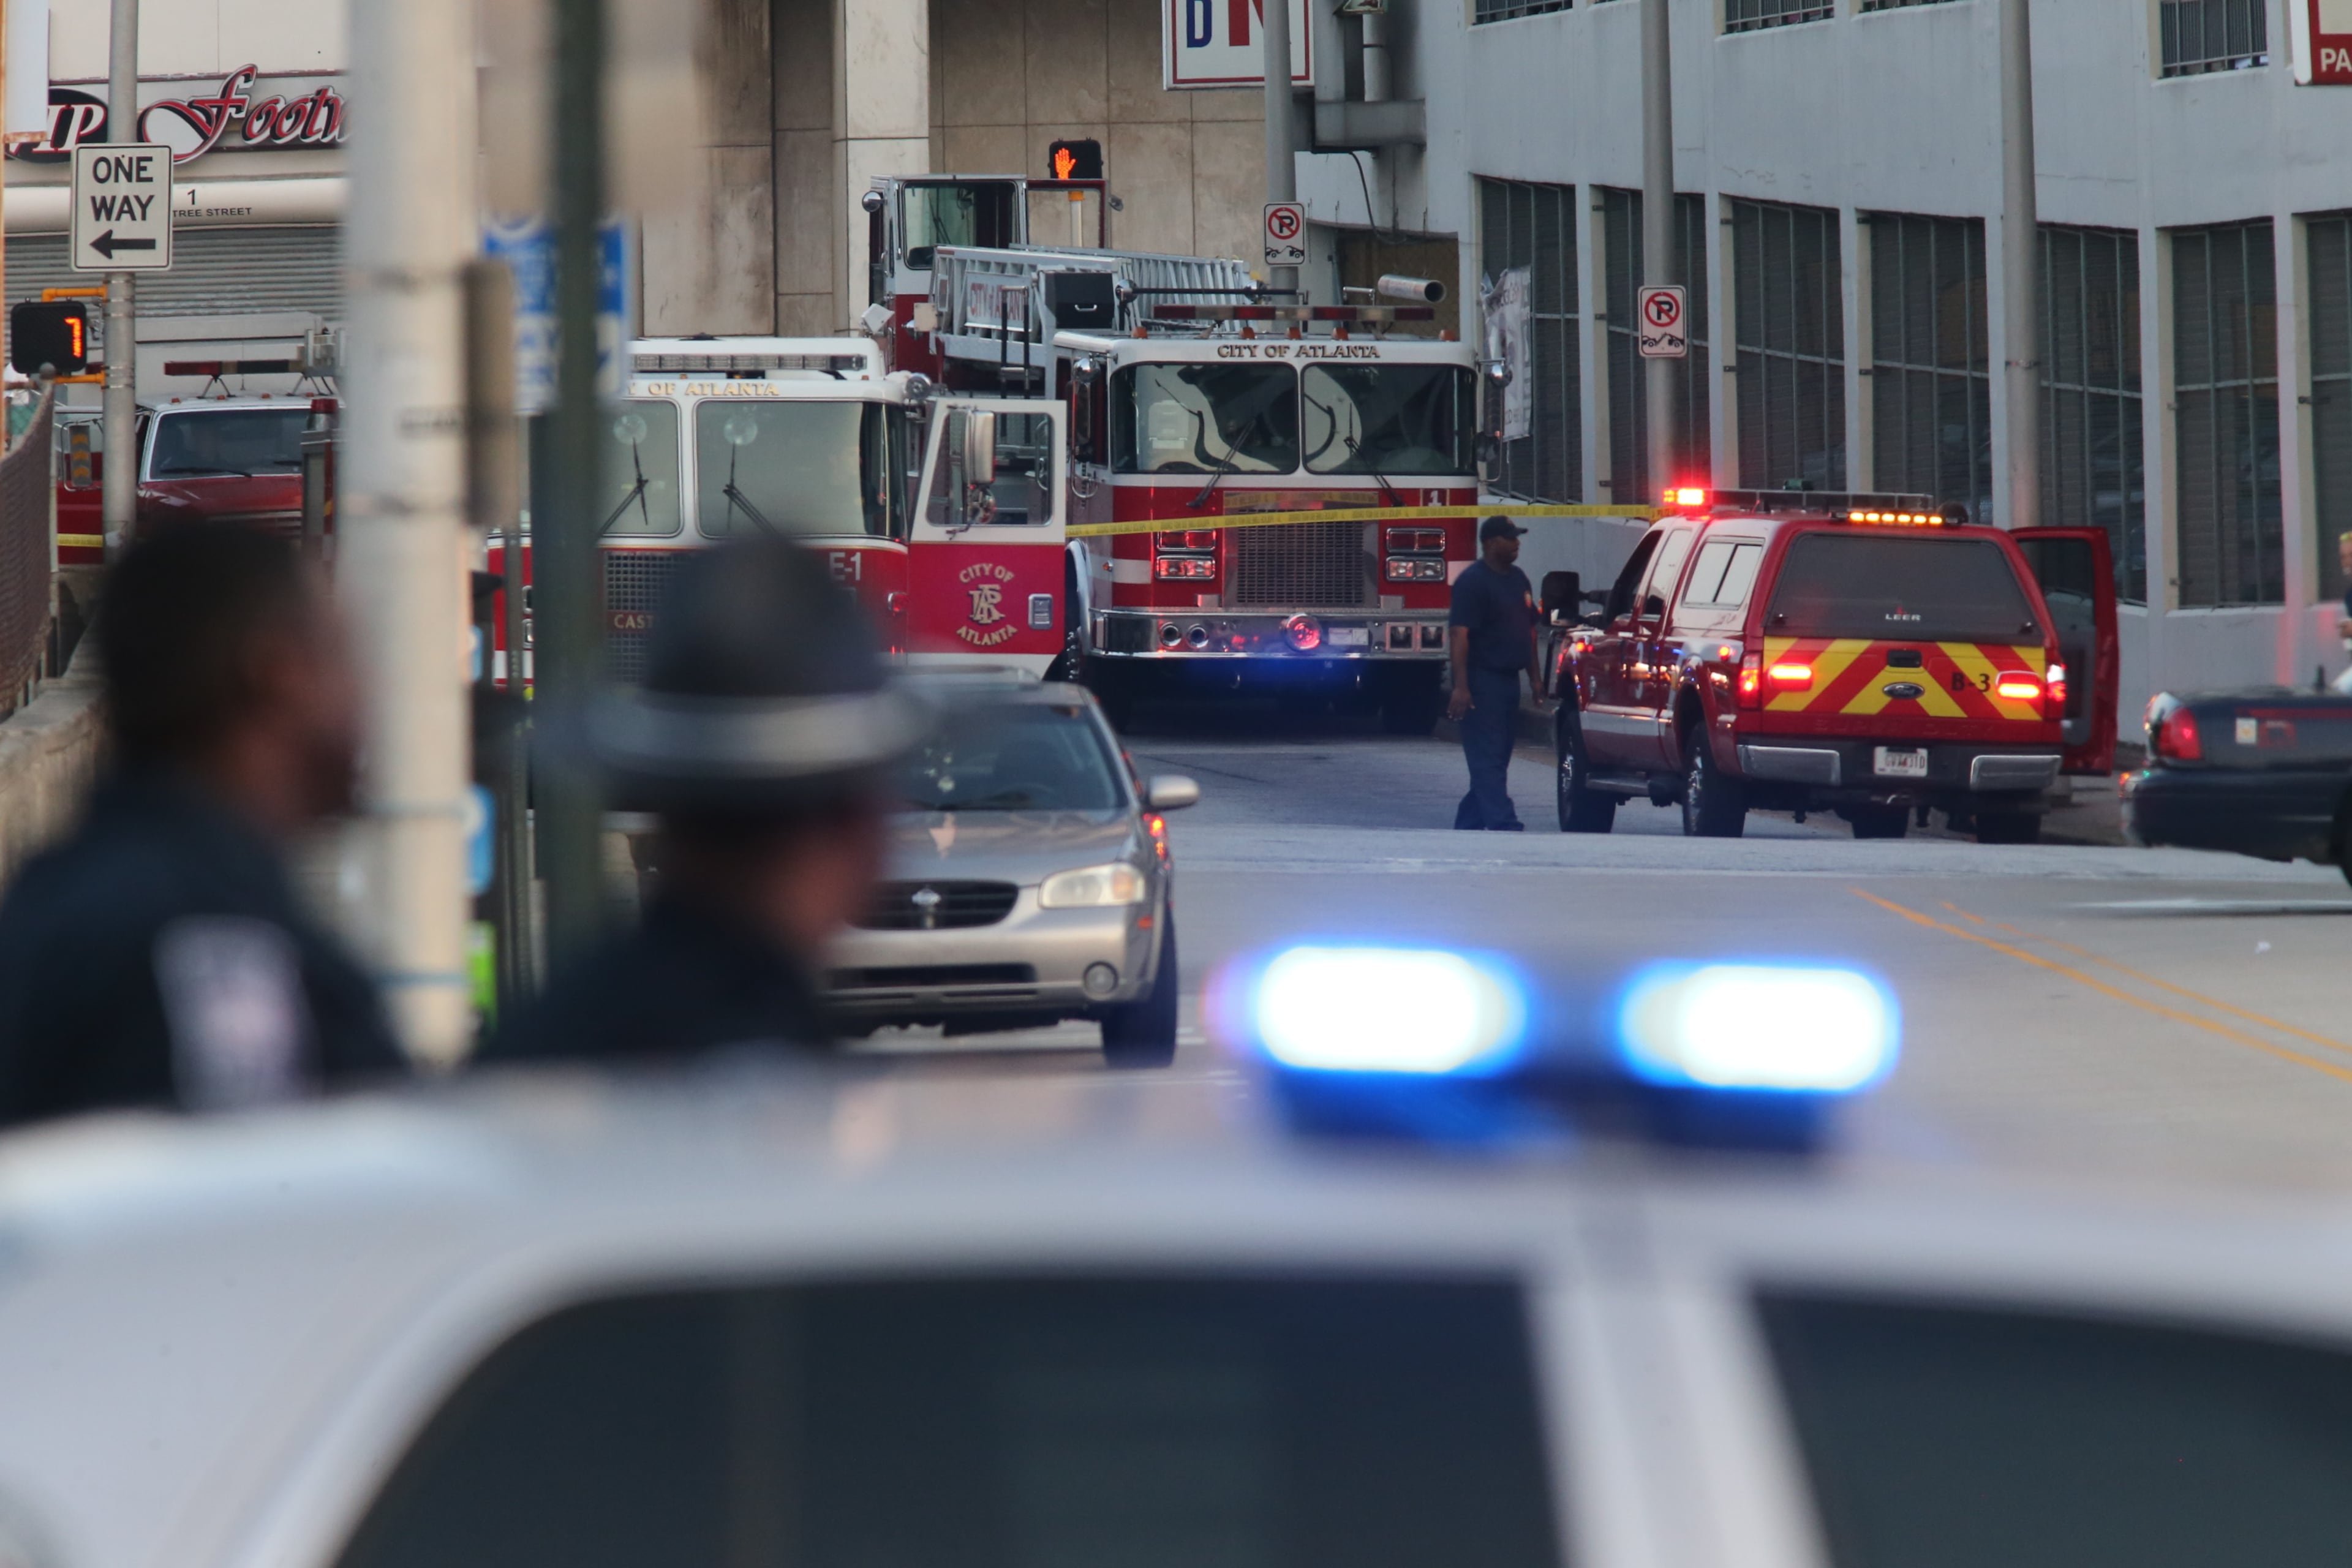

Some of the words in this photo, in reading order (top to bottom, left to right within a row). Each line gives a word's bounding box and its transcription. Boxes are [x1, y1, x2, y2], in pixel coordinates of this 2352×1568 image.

[93, 156, 153, 183] ONE
[187, 189, 195, 205] 1
[90, 195, 155, 221] WAY
[206, 208, 252, 216] STREET
[1217, 344, 1258, 358] CITY
[1264, 344, 1290, 358] OF
[1294, 344, 1381, 359] ATLANTA
[647, 382, 676, 396] OF
[684, 382, 780, 396] ATLANTA
[829, 551, 861, 581] E-1
[959, 563, 993, 583] CITY
[993, 565, 1015, 583] OF
[956, 624, 1019, 646] ATLANTA
[1950, 671, 1991, 693] B-3
